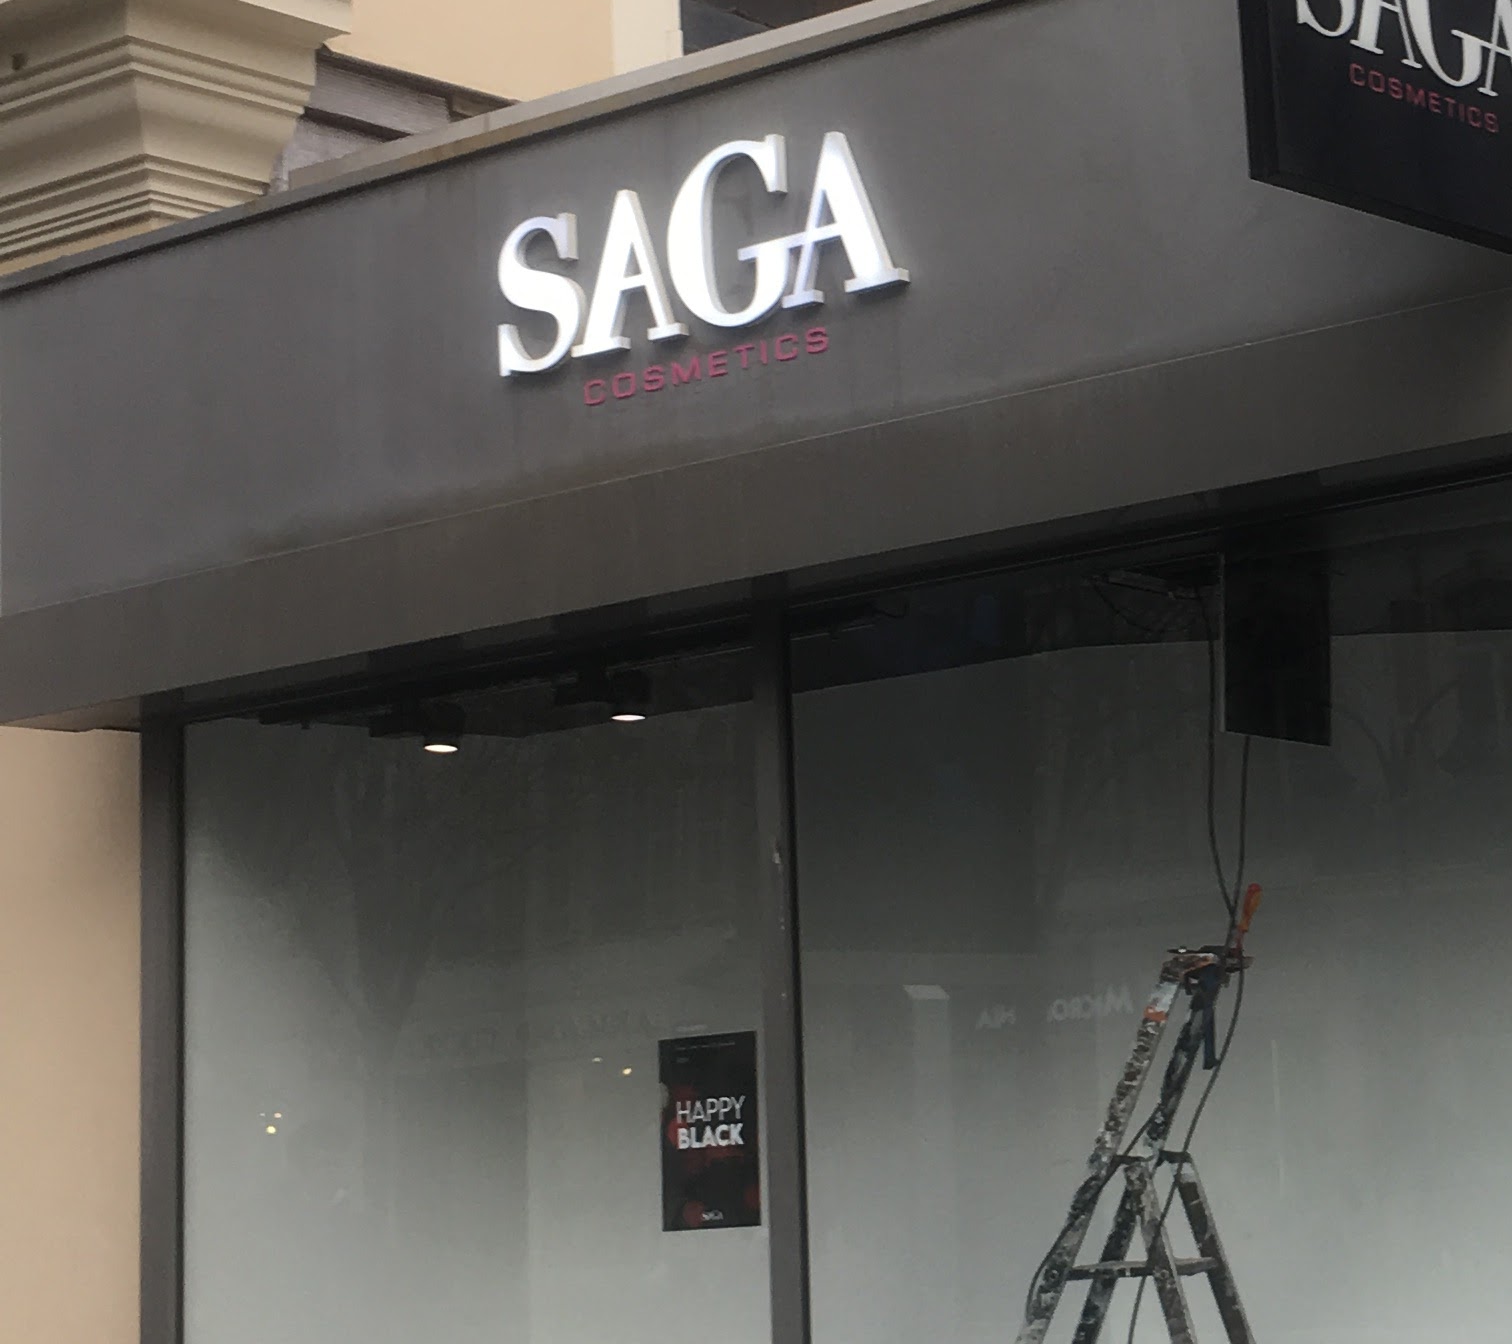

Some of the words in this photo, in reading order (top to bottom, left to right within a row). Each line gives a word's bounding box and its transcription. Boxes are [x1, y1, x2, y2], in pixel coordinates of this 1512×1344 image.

[1349, 62, 1500, 134] COSMETICS
[497, 131, 910, 377] SAGA
[583, 326, 830, 406] COSMETICS
[676, 1095, 746, 1124] HAPPY
[677, 1123, 744, 1149] BLACK
